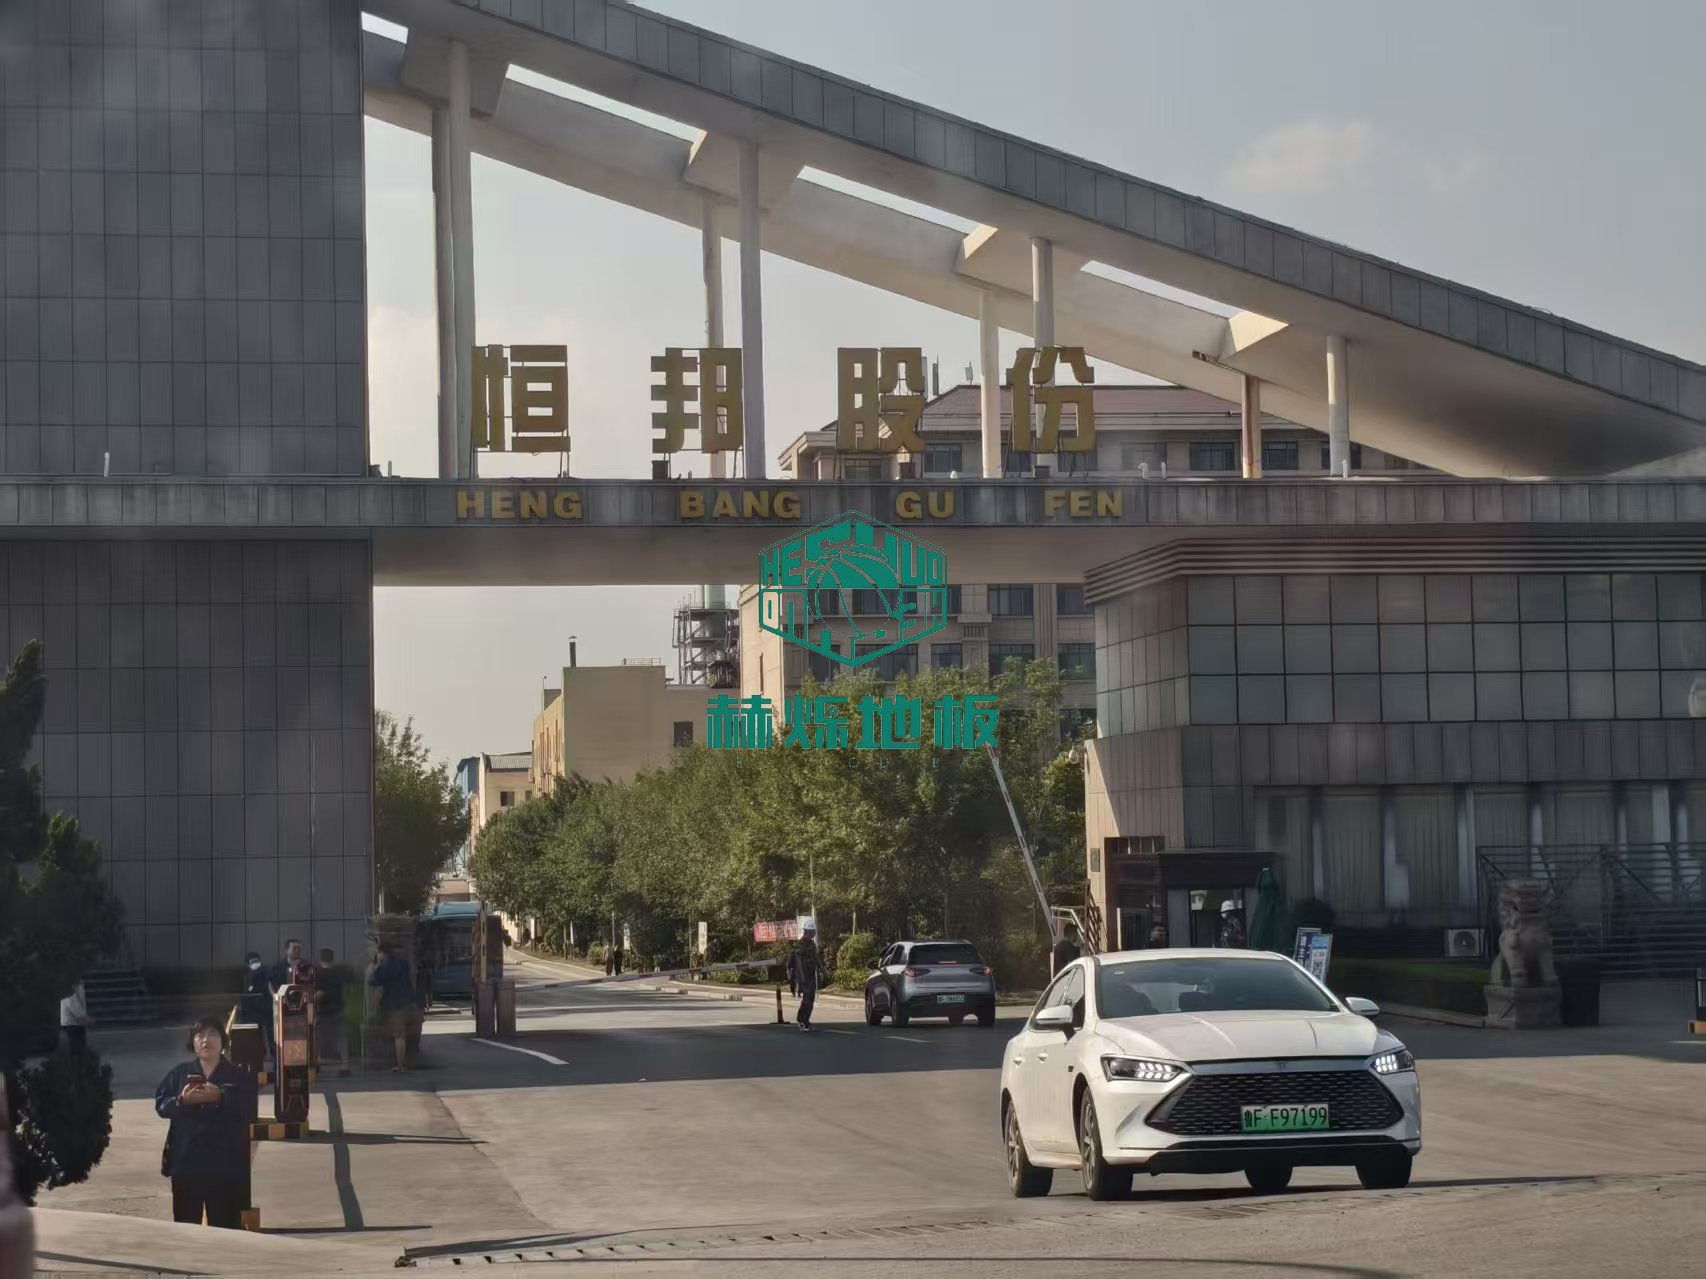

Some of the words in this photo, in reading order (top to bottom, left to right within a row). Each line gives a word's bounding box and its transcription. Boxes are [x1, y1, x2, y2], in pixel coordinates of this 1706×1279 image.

[471, 345, 1095, 453] 恒邦股份
[457, 490, 583, 519] HENG
[679, 490, 801, 518] BANG
[895, 490, 954, 518] GU
[1044, 490, 1123, 517] FEN
